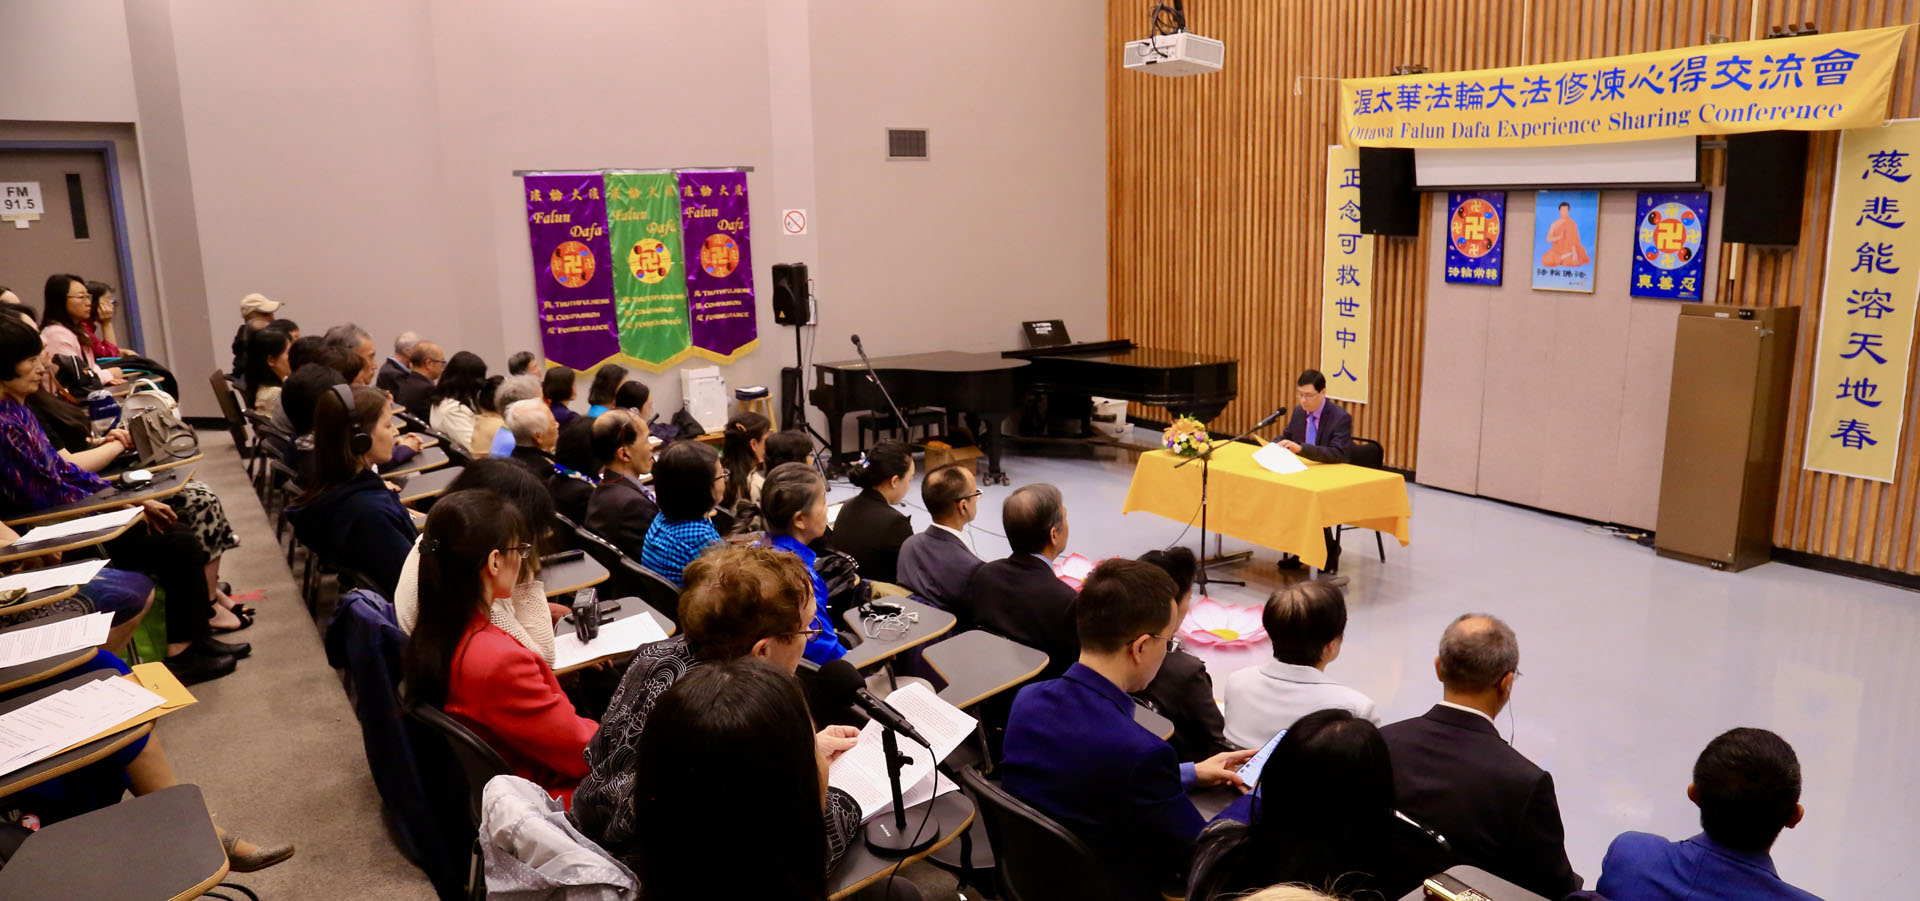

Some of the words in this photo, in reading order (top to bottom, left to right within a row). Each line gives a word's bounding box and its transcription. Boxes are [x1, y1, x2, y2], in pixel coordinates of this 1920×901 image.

[1353, 48, 1861, 116] 渥太華法輪大法修煉心得交流會
[1349, 125, 1394, 141] Ottawa
[1400, 121, 1445, 139] Falun
[1451, 120, 1490, 139] Dafa
[1498, 116, 1601, 139] Experience
[1608, 107, 1691, 131] Sharing
[1698, 102, 1843, 123] Conference
[7, 186, 28, 197] FM
[5, 198, 35, 210] 91.5
[686, 204, 718, 218] Falun
[533, 210, 571, 224] Falun
[613, 207, 648, 221] Falun
[570, 222, 602, 241] Dafa
[646, 219, 677, 237] Dafa
[717, 217, 744, 234] Dafa
[1332, 168, 1363, 382] 正念可救世中人
[1830, 149, 1913, 451] 慈悲能溶天地春
